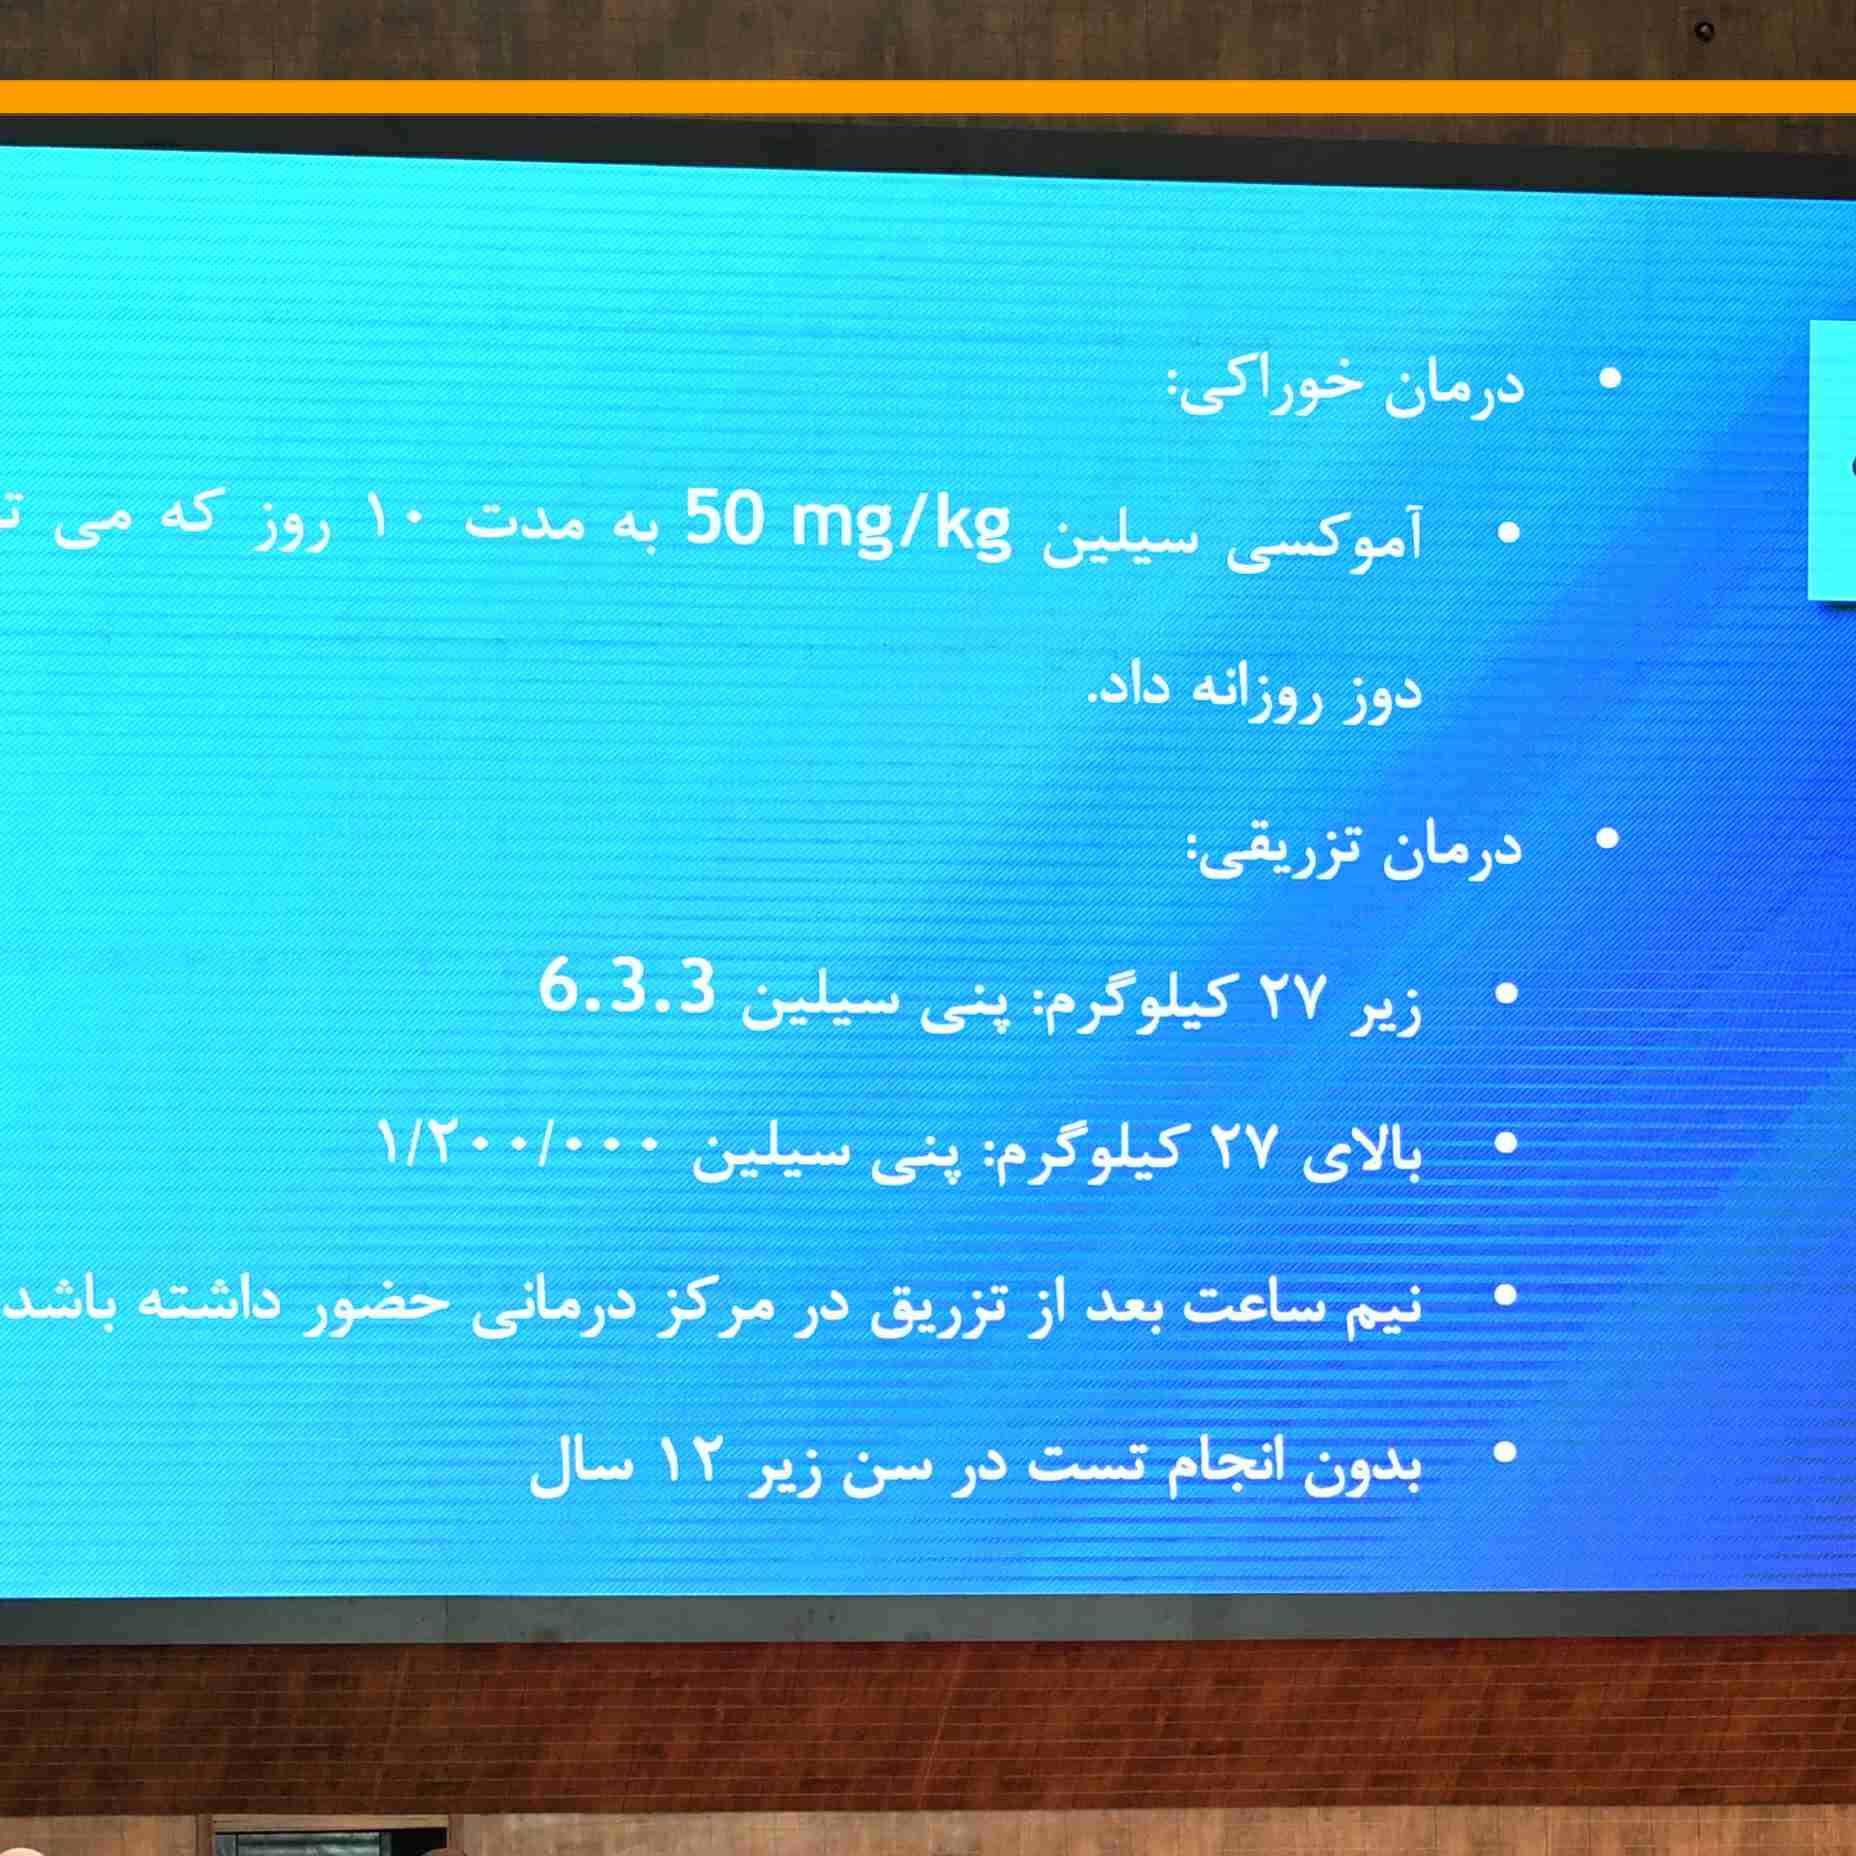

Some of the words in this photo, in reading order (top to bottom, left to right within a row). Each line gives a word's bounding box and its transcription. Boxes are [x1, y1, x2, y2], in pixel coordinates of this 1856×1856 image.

[1167, 351, 1364, 417] خوراکی:
[1385, 356, 1525, 421] درمان
[54, 510, 132, 550] می
[161, 487, 225, 532] که
[255, 502, 331, 554] روز
[367, 492, 422, 536] ۱۰
[465, 505, 585, 540] مدت
[613, 511, 659, 555] به
[687, 487, 765, 545] 50
[793, 491, 1013, 564] mg/kg
[1043, 507, 1199, 569] سیلین
[1227, 504, 1423, 575] آموکسی
[1087, 658, 1170, 704] داد.
[1193, 660, 1323, 725] روزانه
[1343, 677, 1422, 726] دوز
[1187, 820, 1362, 880] تزریقی:
[1383, 817, 1522, 882] درمان
[539, 955, 715, 1013] 6.3.3
[742, 967, 900, 1031] سیلین
[920, 984, 1010, 1034] پنی
[1033, 969, 1240, 1036] کیلوگرم:
[1259, 974, 1327, 1019] ۲۷
[1350, 989, 1422, 1038] زیر
[378, 1119, 657, 1167] ۱/۲۰۰/۰۰۰
[693, 1119, 850, 1184] سیلین
[871, 1135, 961, 1186] پنی
[984, 1119, 1192, 1186] کیلوگرم:
[1211, 1123, 1279, 1169] ۲۷
[1303, 1123, 1422, 1184] بالای
[3, 1271, 117, 1333] باشد
[138, 1272, 281, 1320] داشته
[303, 1280, 449, 1338] حضور
[472, 1272, 636, 1340] درمانی
[657, 1274, 775, 1339] مرکز
[794, 1290, 849, 1340] در
[871, 1285, 1009, 1340] تزریق
[1028, 1275, 1065, 1340] از
[1086, 1289, 1164, 1335] بعد
[1183, 1275, 1326, 1323] ساعت
[1346, 1285, 1422, 1341] نیم
[530, 1433, 634, 1500] سال
[661, 1435, 724, 1481] ۱۲
[748, 1449, 822, 1499] زیر
[843, 1452, 933, 1499] سن
[951, 1449, 1008, 1499] در
[1028, 1443, 1148, 1482] تست
[1168, 1433, 1284, 1499] انجام
[1304, 1447, 1422, 1499] بدون
